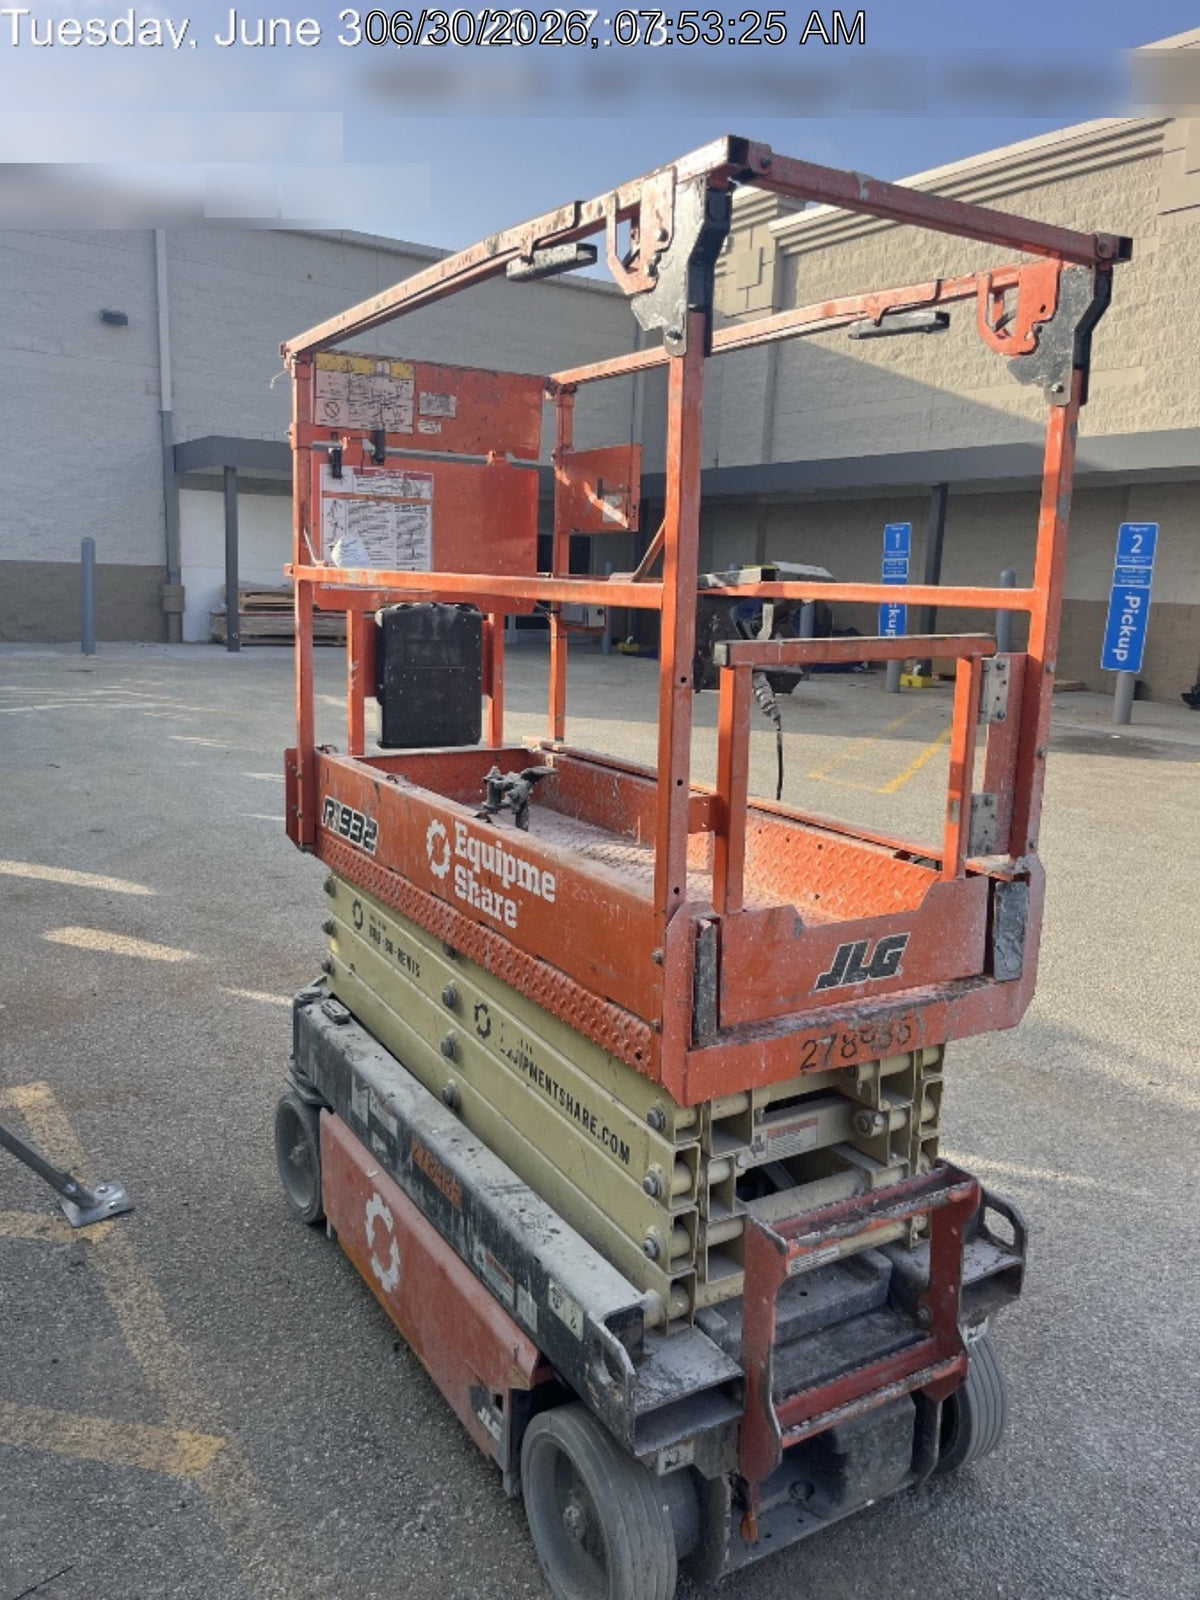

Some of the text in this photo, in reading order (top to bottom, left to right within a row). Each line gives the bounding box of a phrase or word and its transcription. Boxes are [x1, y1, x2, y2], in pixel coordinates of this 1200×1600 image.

[1130, 534, 1143, 554] 2
[1112, 594, 1142, 662] Pickup
[813, 932, 911, 992] JLG
